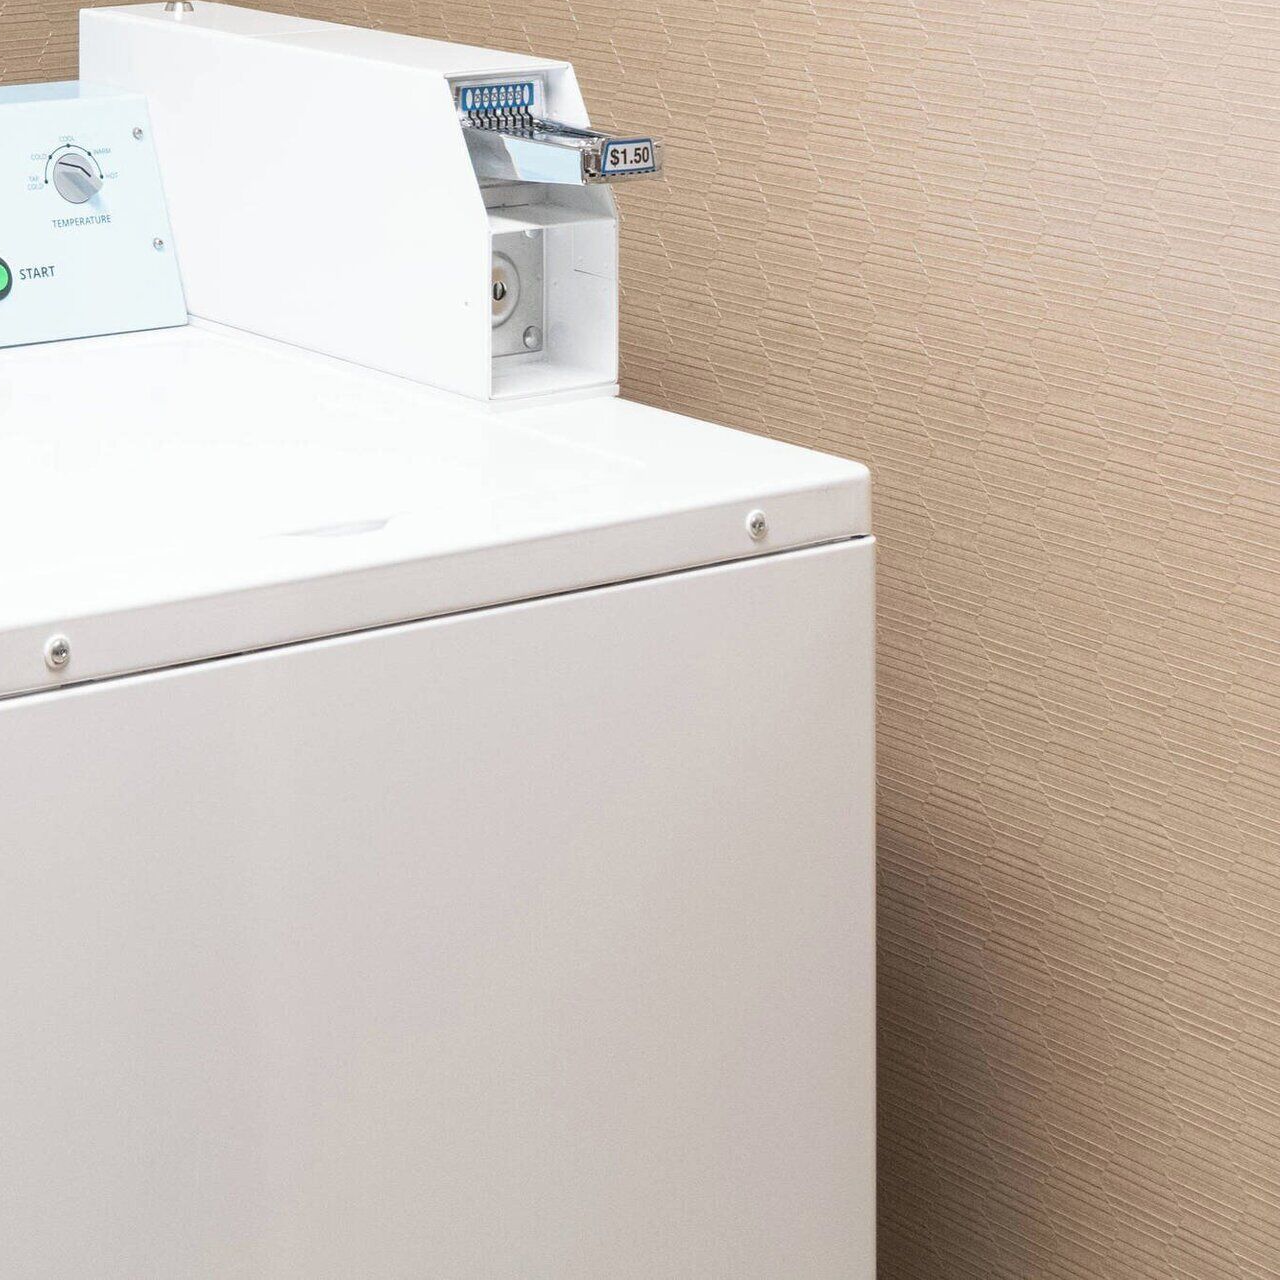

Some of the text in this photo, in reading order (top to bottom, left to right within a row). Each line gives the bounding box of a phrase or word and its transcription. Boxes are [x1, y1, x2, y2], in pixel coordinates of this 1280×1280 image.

[610, 146, 650, 167] $1.50
[52, 215, 111, 228] TEMPERATURE
[19, 265, 55, 281] START
